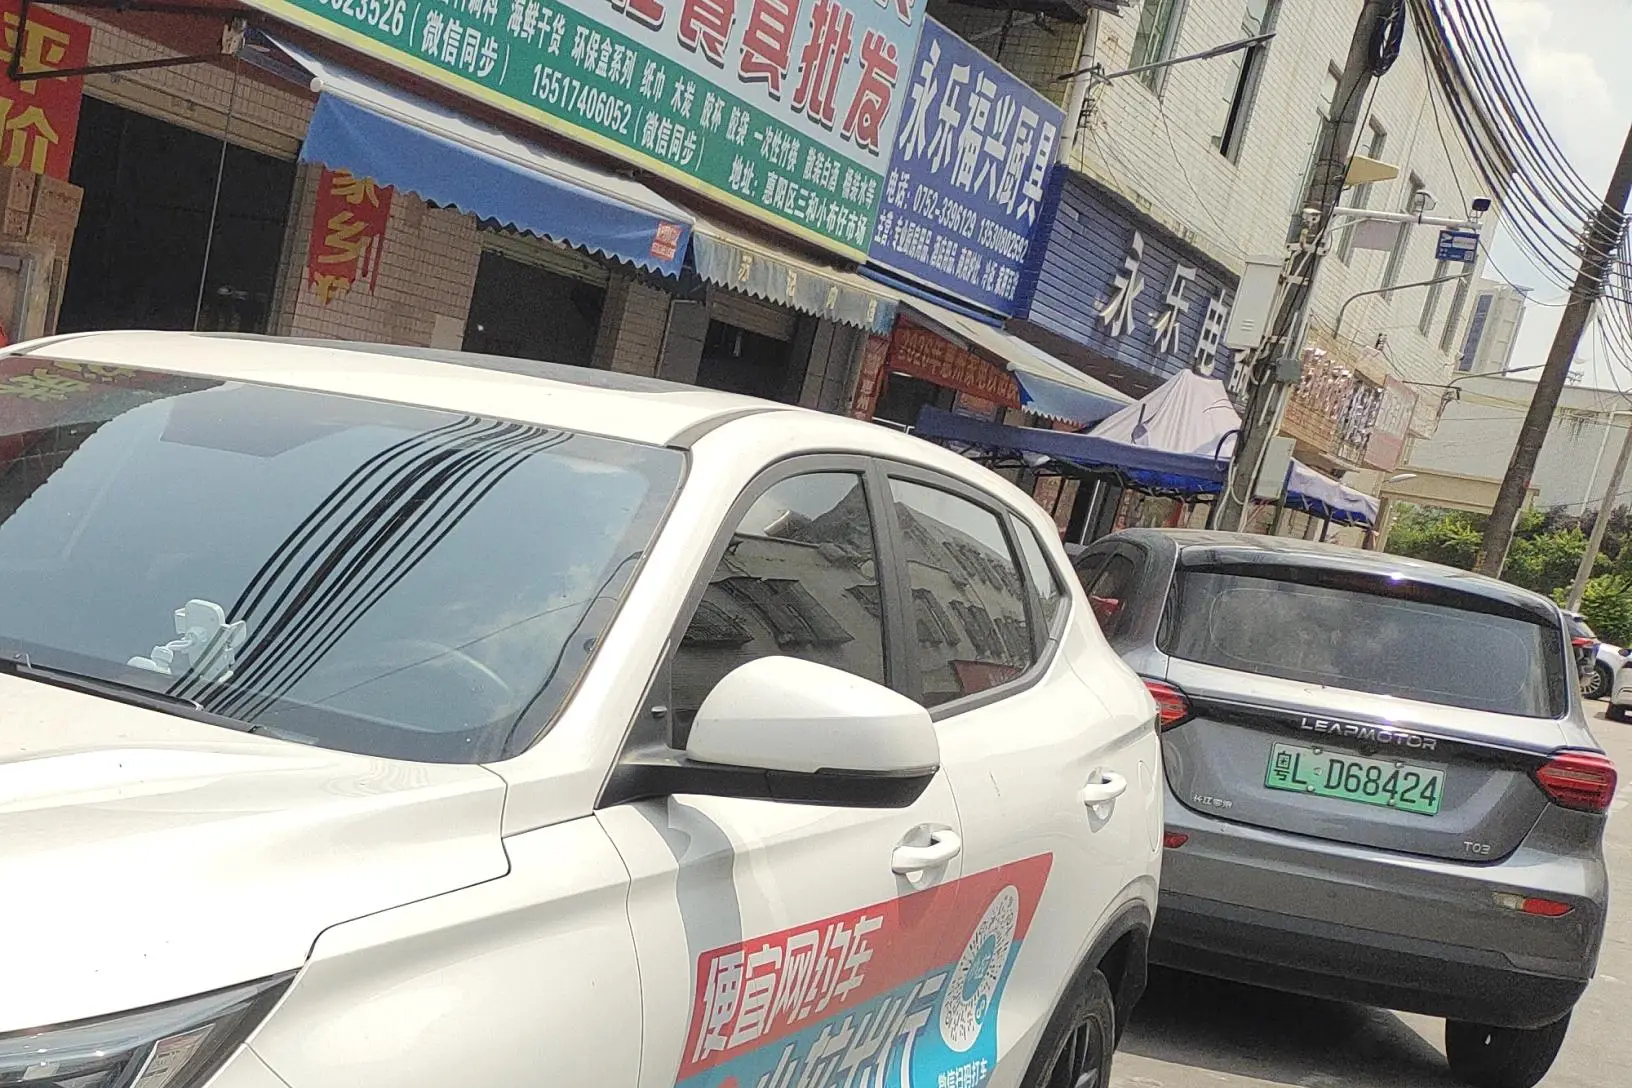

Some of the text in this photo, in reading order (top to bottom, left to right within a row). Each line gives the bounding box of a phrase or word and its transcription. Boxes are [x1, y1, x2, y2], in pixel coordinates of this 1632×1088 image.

[506, 0, 566, 56] 海鲜干货
[571, 25, 637, 89] 环保盒系列
[640, 59, 666, 102] 纸巾
[671, 75, 696, 119] 木炭
[726, 106, 750, 146] 胶袋
[899, 38, 1056, 228] 永乐福兴厨具
[1300, 717, 1437, 751] LEAPMOTOR
[1463, 841, 1491, 855] T03
[692, 914, 883, 1064] 便宜网约车
